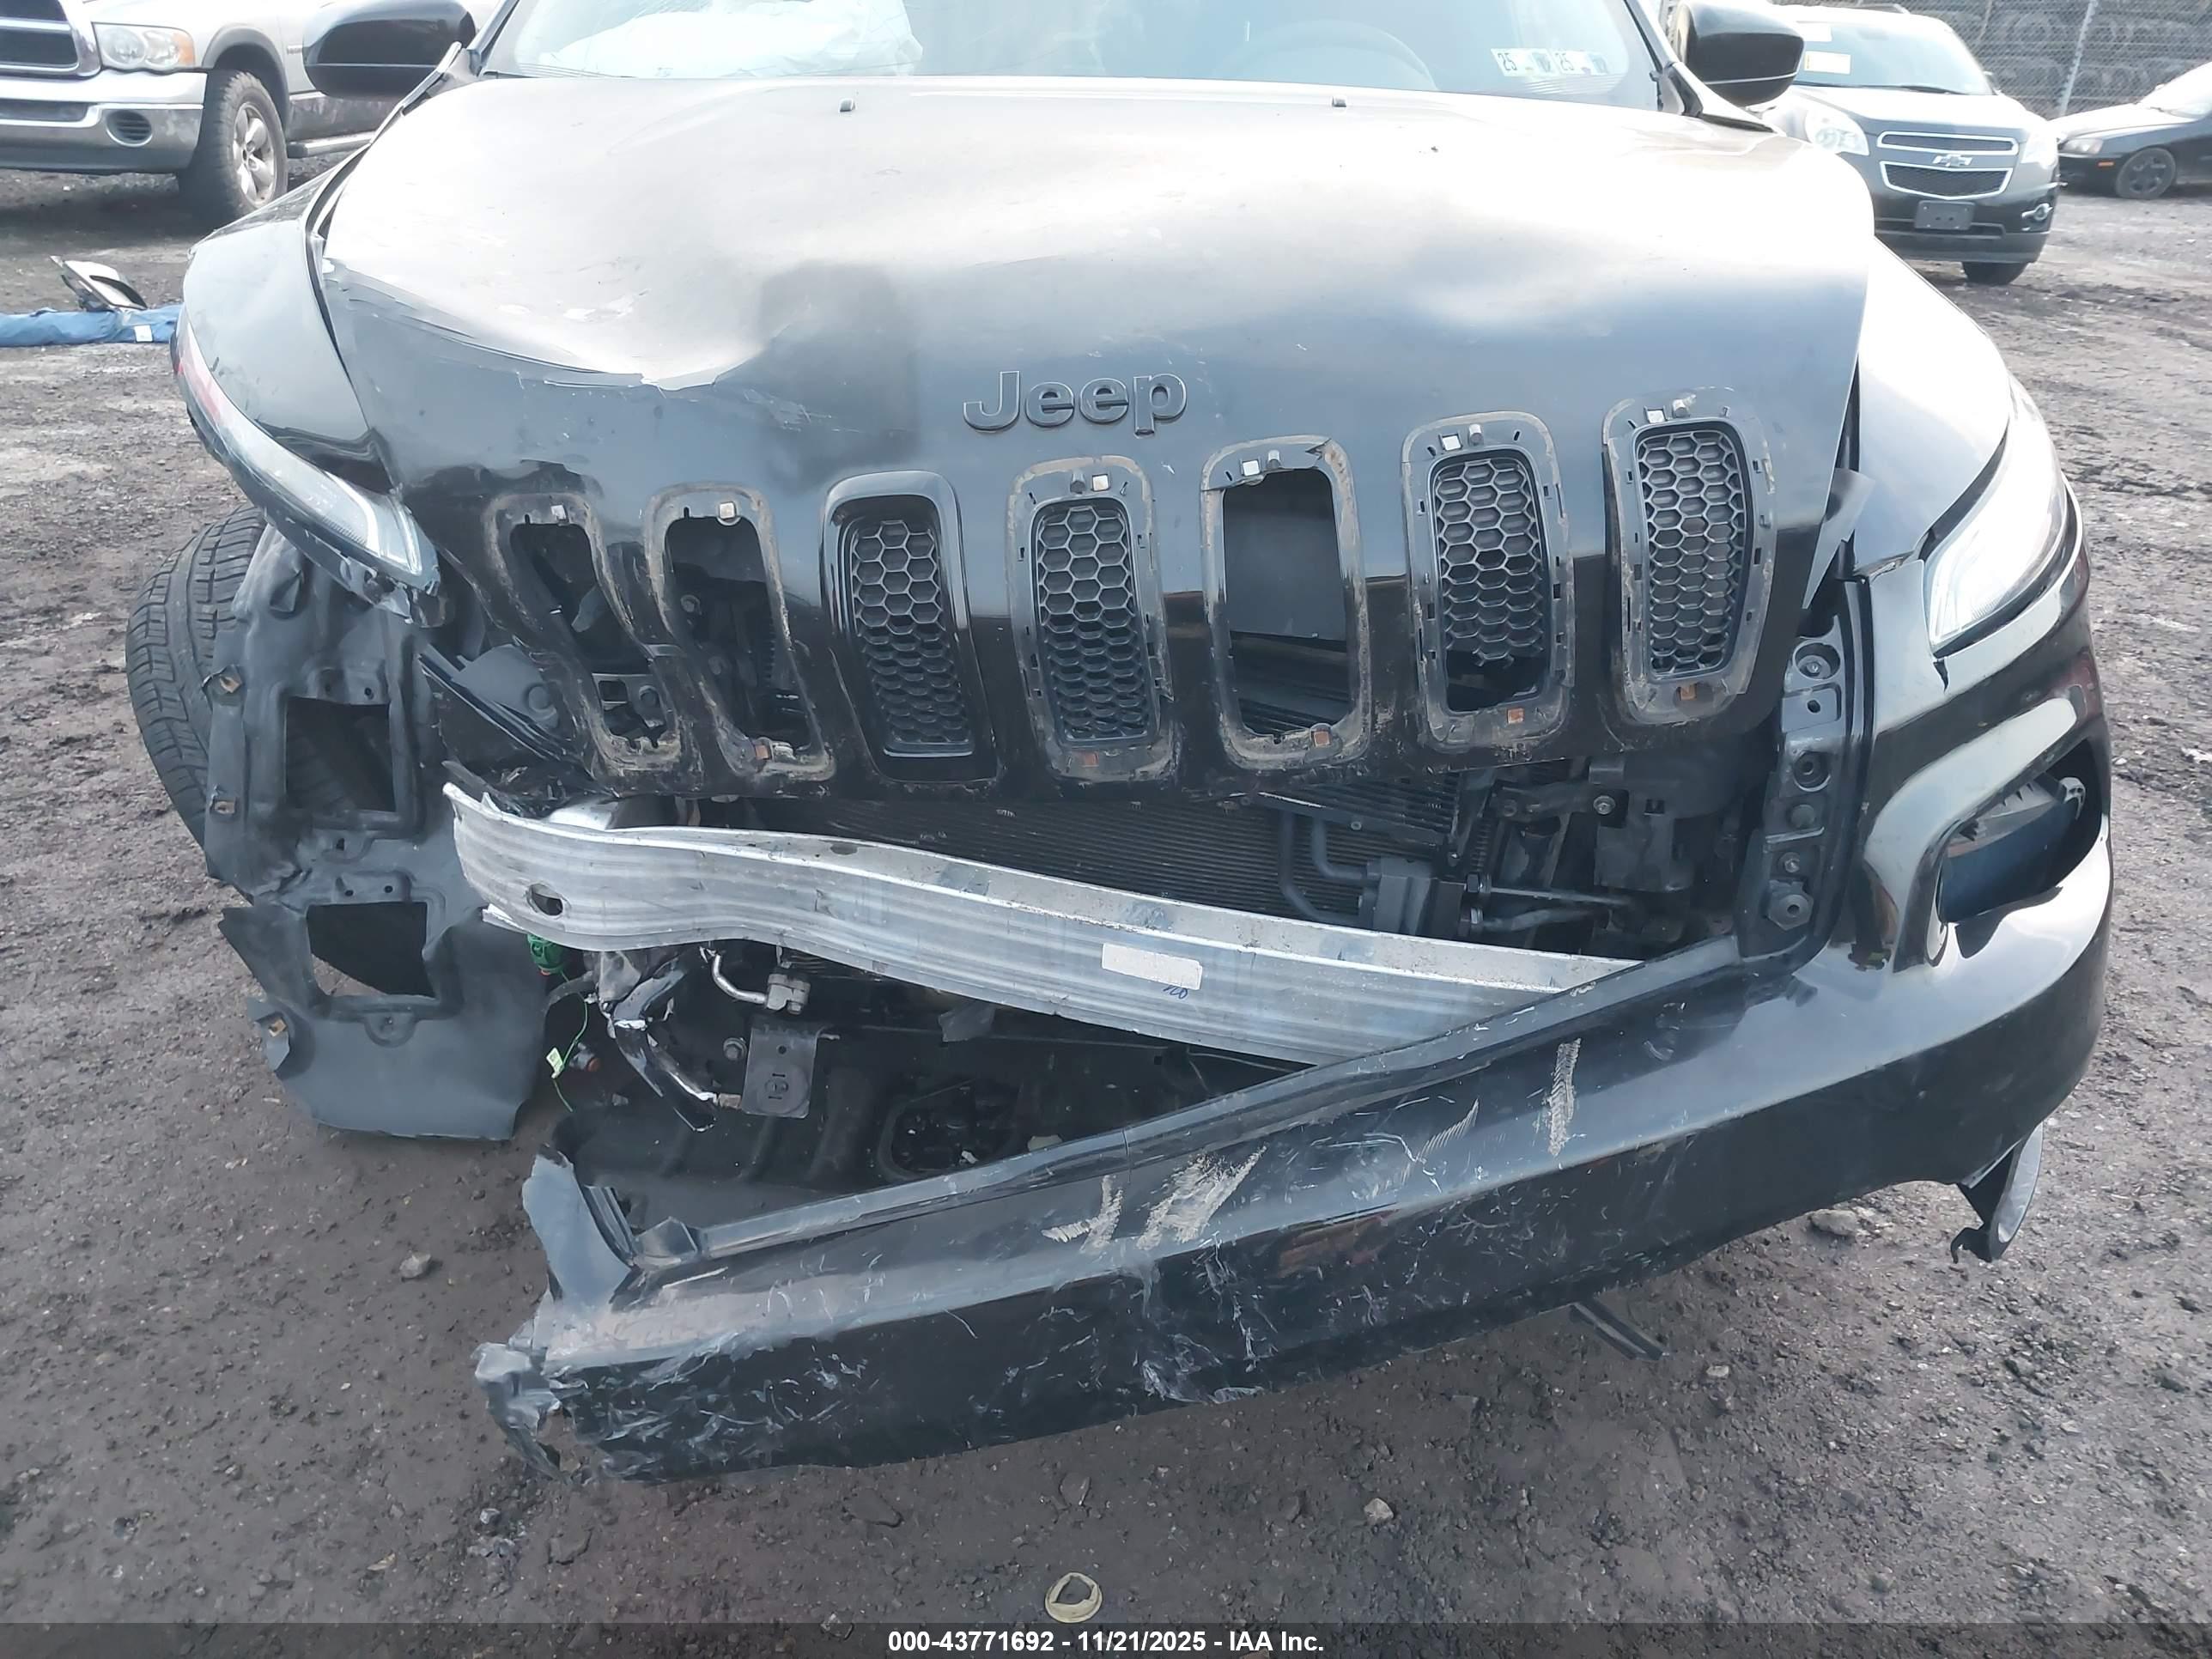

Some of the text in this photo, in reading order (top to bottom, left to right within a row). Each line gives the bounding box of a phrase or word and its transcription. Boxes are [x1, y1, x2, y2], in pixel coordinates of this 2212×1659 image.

[1497, 52, 1518, 71] 25
[1554, 52, 1575, 71] 25
[963, 370, 1188, 437] Jeep
